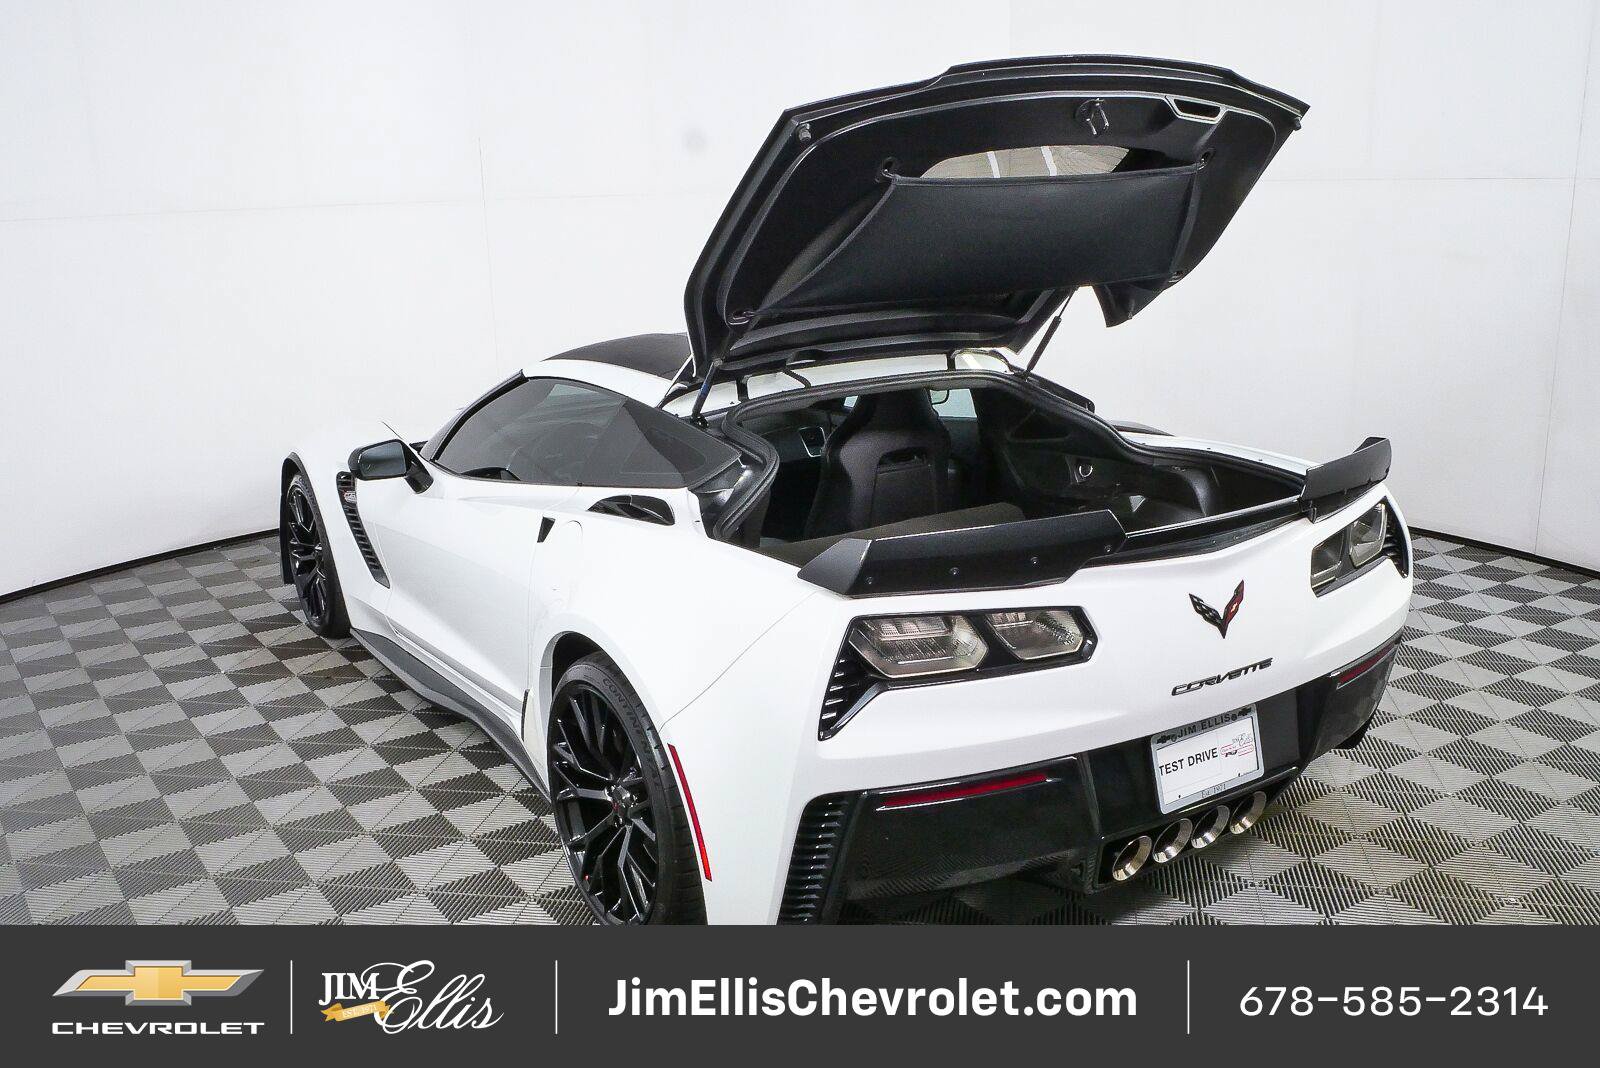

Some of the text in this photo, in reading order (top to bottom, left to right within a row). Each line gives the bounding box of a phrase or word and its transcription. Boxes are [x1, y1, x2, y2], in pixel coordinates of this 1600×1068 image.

[1171, 657, 1273, 696] CORVETTE
[1178, 714, 1231, 739] JIM ELLIS
[1159, 758, 1184, 776] TEST
[1187, 747, 1218, 767] DRIVE
